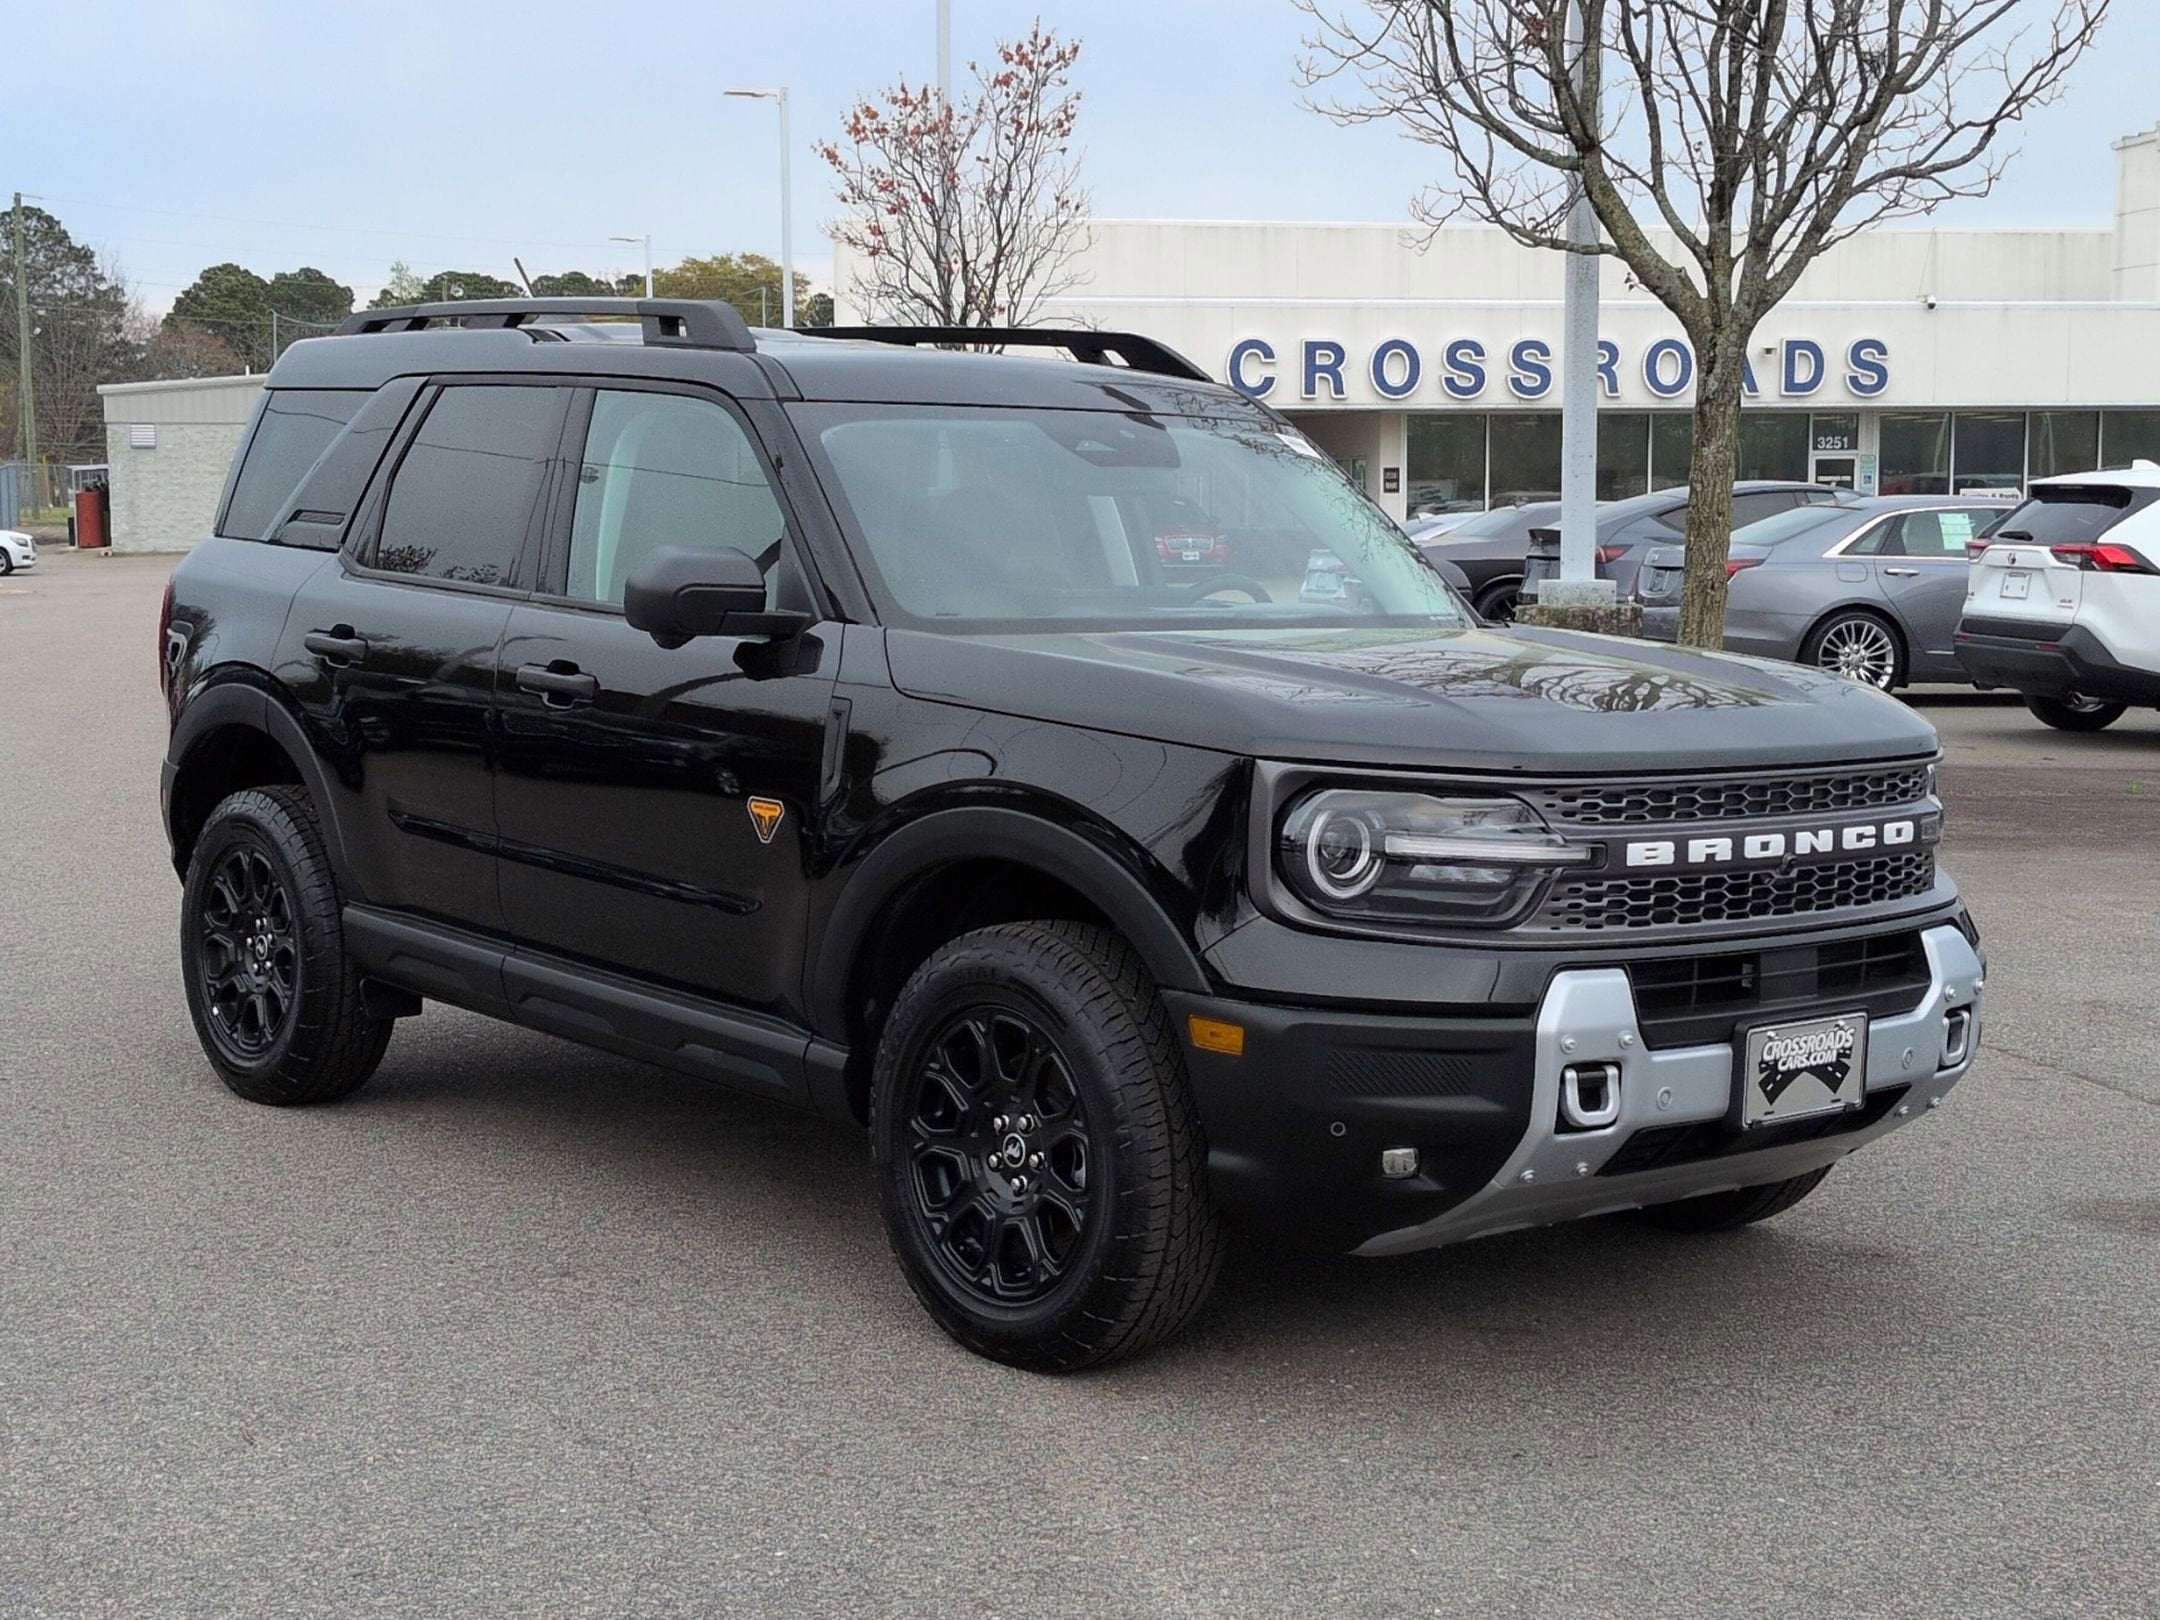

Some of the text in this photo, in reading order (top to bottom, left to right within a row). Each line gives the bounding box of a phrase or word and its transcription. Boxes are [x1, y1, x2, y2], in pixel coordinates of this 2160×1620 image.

[1228, 338, 1890, 398] CROSSRODS
[1817, 436, 1849, 450] 3251
[1626, 820, 1915, 867] BRONCO
[1762, 1028, 1855, 1061] CROSSROADS
[1777, 1049, 1838, 1071] CARS.COM
